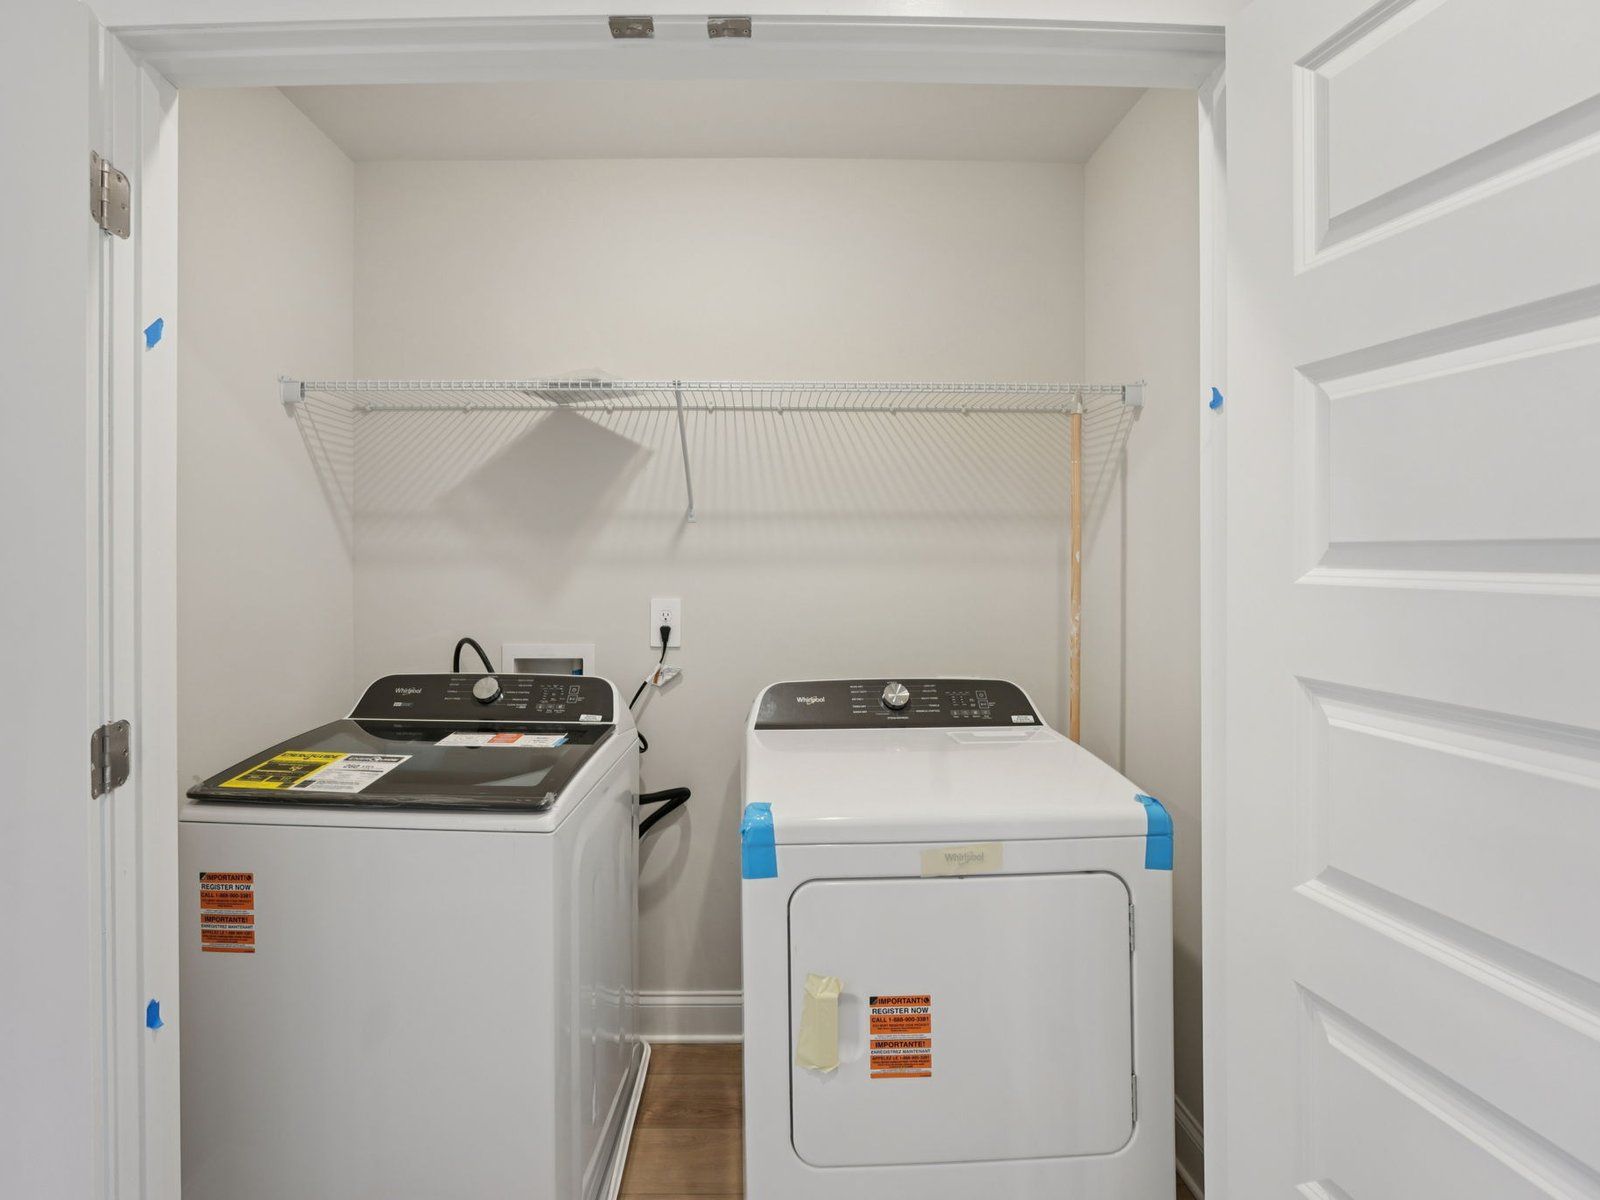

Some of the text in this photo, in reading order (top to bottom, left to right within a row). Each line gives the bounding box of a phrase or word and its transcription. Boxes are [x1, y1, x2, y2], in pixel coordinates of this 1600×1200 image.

[395, 687, 423, 696] Whirlpool
[796, 696, 826, 705] Whirlpool
[944, 848, 984, 865] Whirlpool
[872, 1007, 909, 1015] REGISTER
